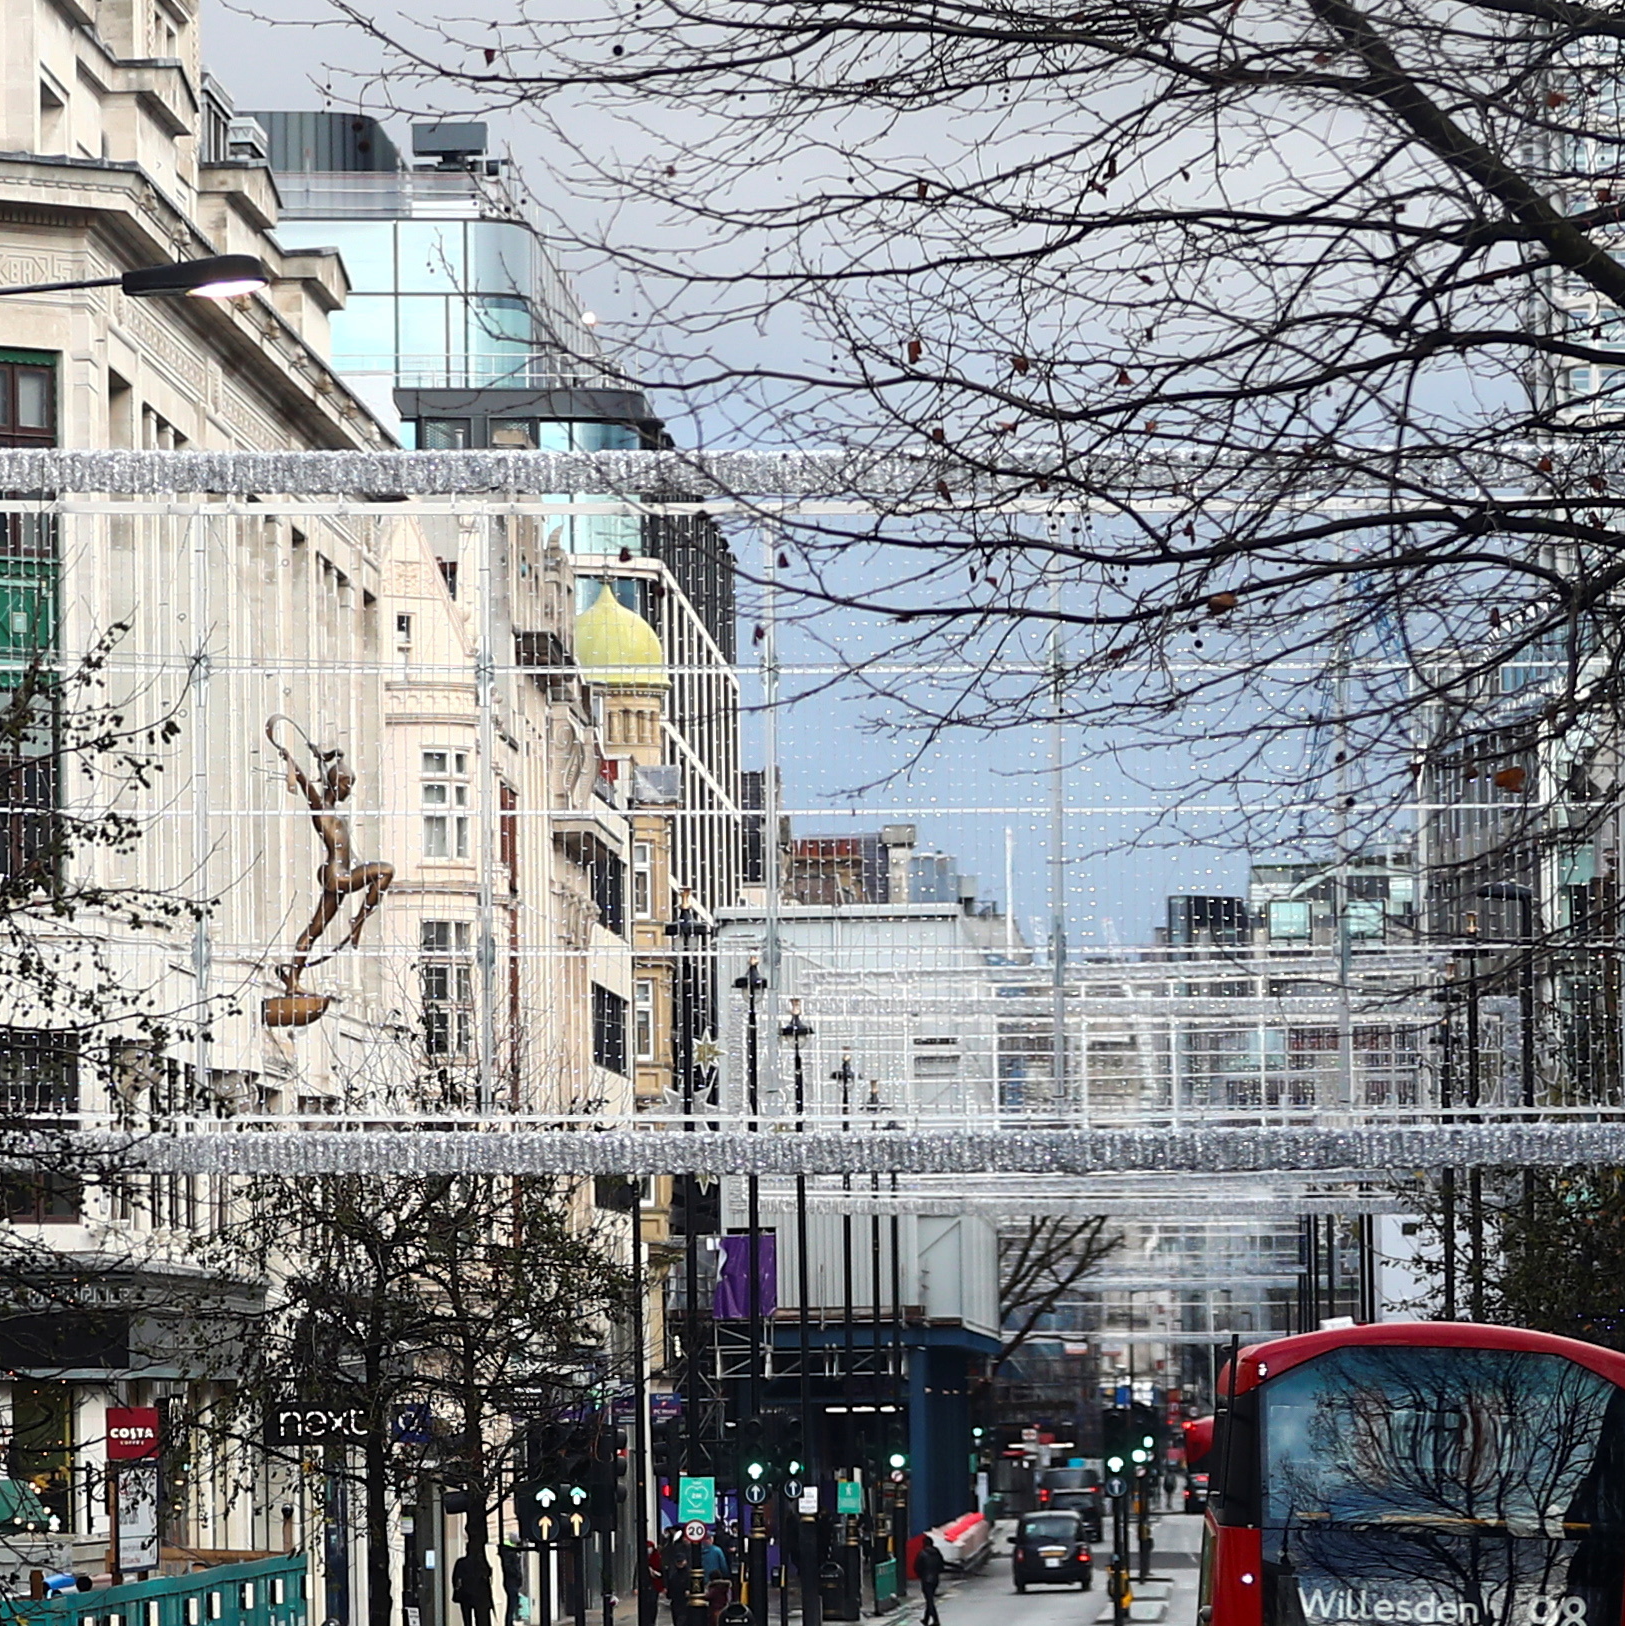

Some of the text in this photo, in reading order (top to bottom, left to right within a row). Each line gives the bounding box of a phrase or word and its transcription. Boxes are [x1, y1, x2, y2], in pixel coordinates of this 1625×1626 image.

[279, 1408, 368, 1437] next
[110, 1427, 154, 1440] COSTA
[688, 1526, 704, 1536] 20
[1298, 1587, 1479, 1625] Willesden
